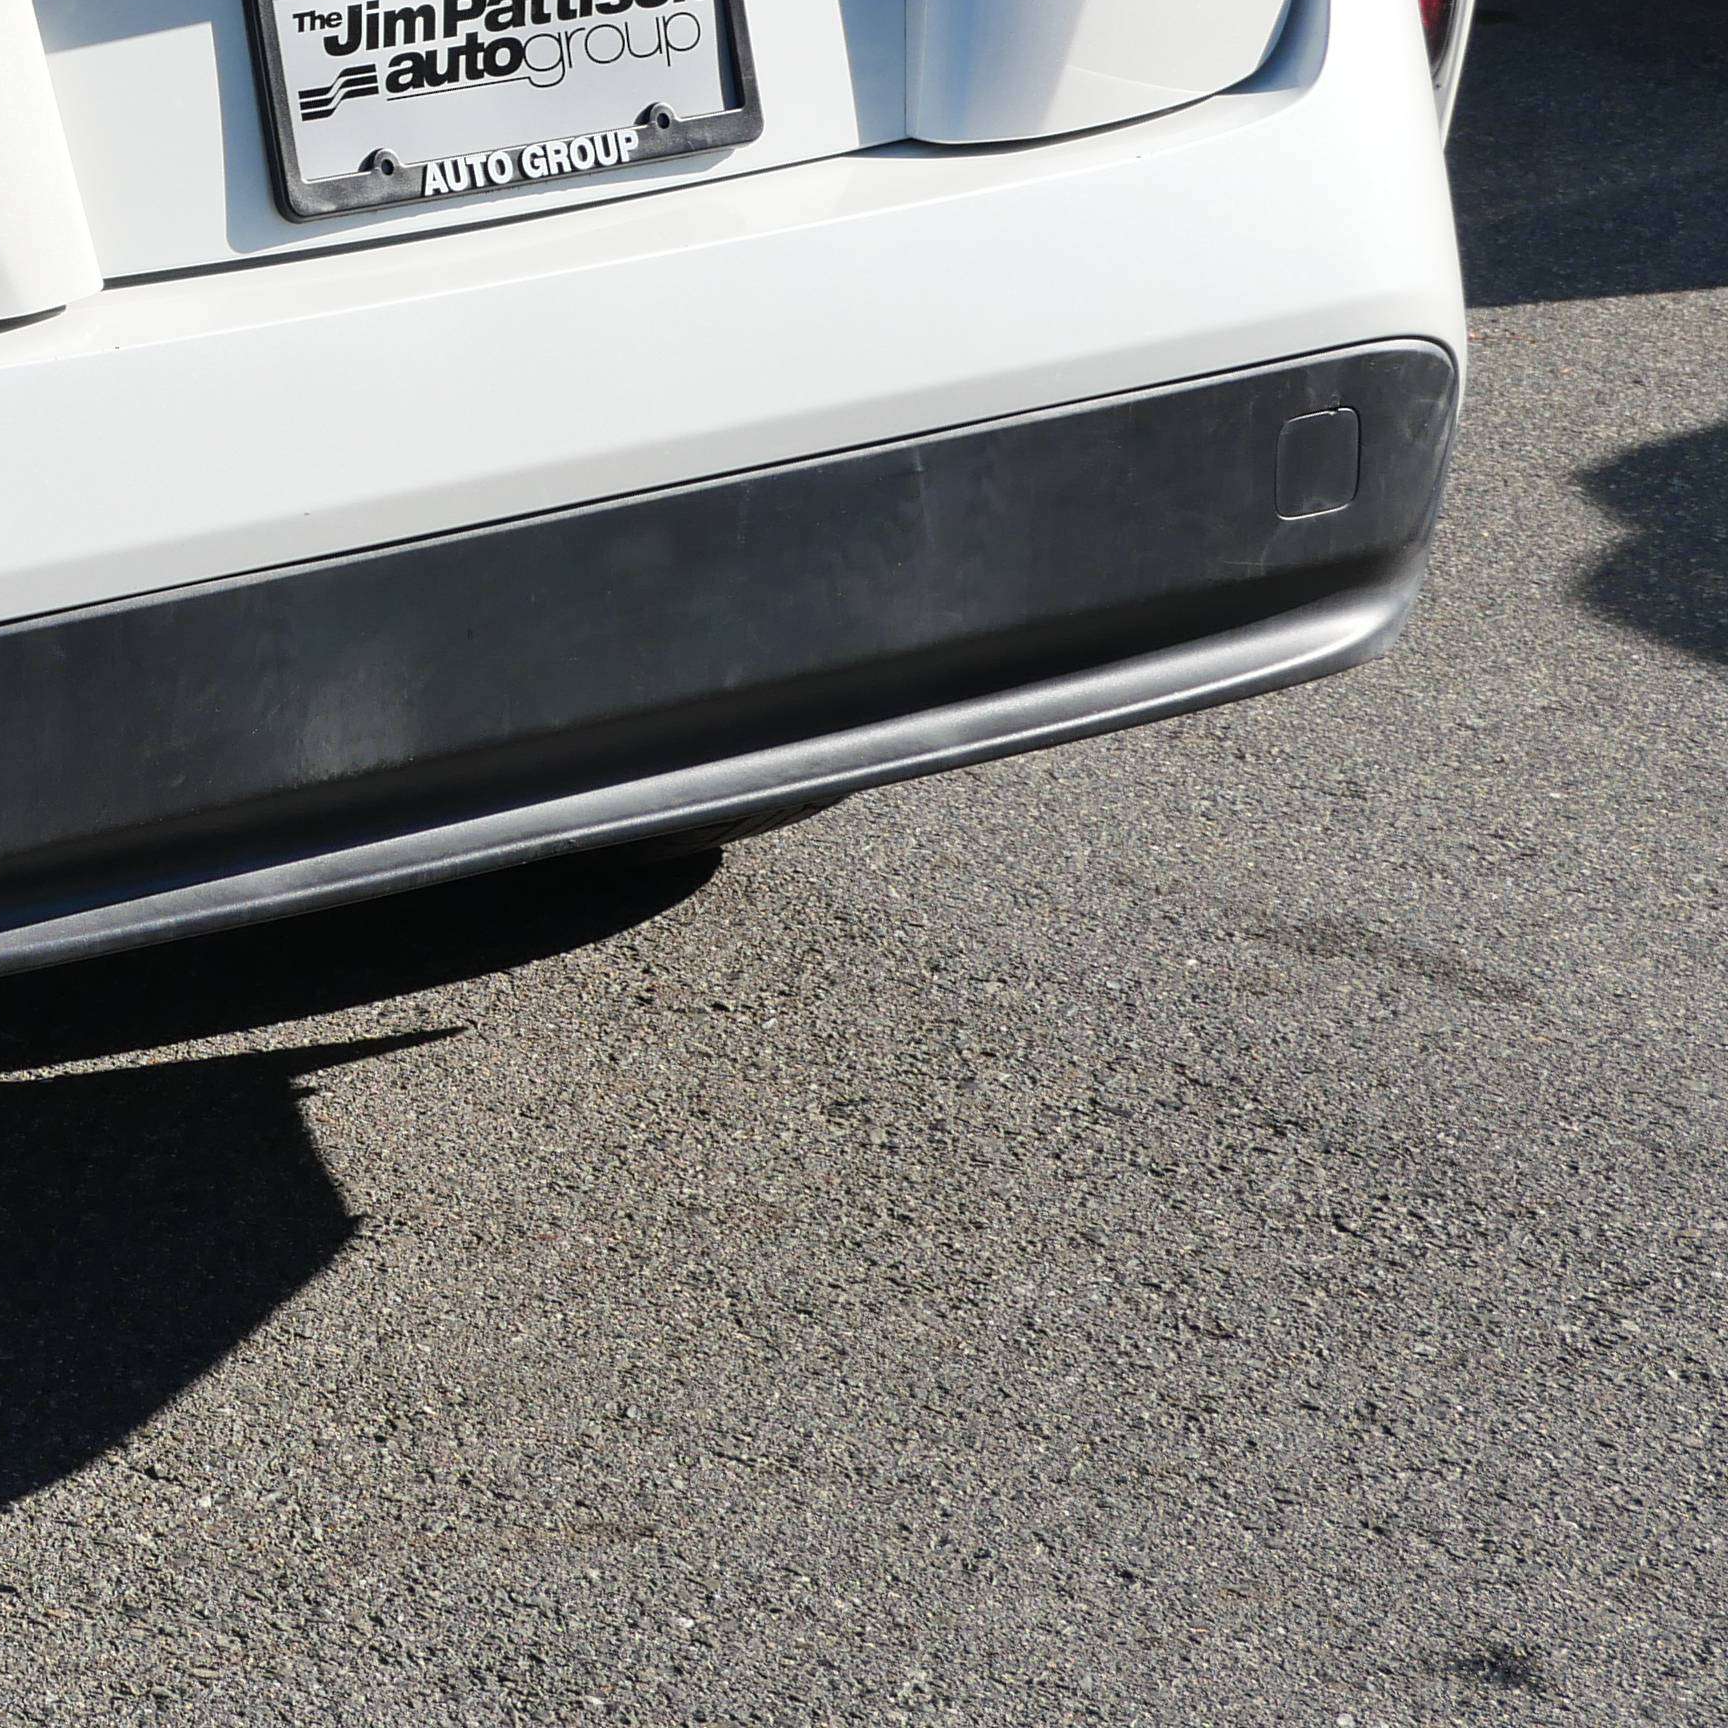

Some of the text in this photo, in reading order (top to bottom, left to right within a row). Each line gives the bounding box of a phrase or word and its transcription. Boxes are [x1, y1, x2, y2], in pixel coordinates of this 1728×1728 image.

[292, 9, 343, 33] The
[323, 0, 438, 58] Jim
[423, 128, 640, 197] AUTO GROUP
